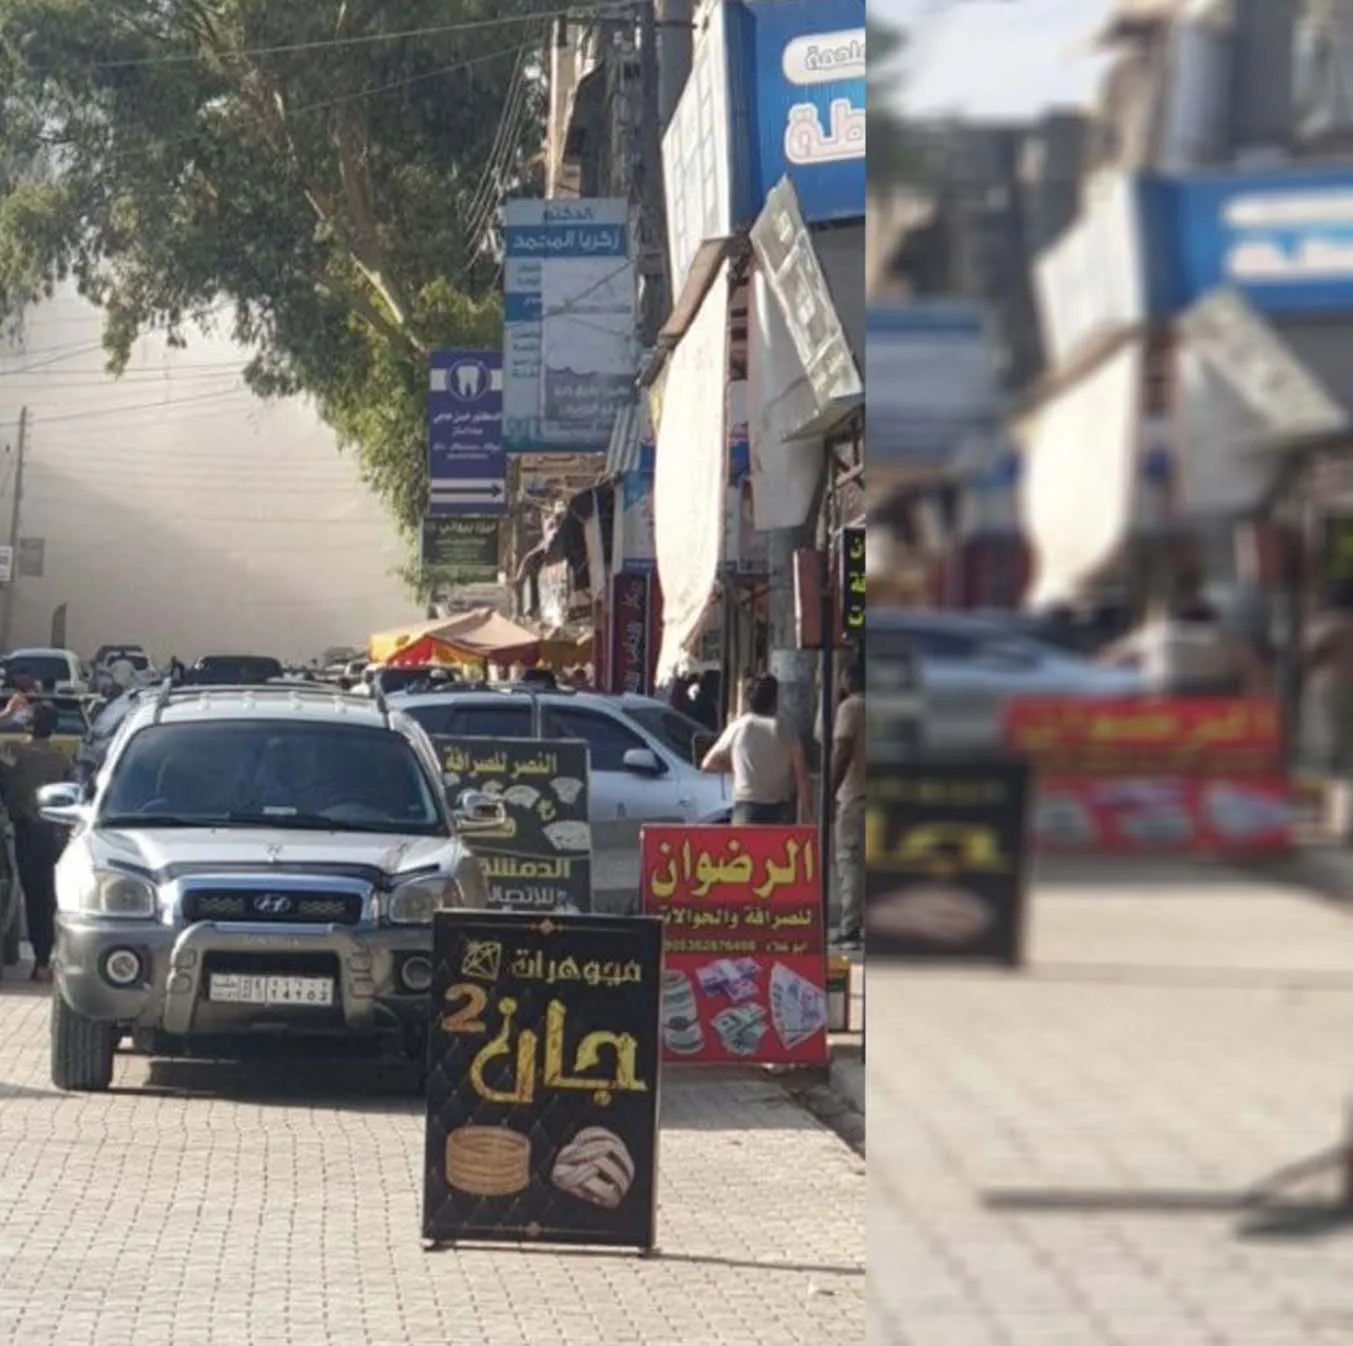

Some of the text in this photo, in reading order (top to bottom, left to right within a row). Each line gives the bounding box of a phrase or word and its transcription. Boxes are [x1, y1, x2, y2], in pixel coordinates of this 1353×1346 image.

[651, 838, 814, 898] الرضوان
[744, 903, 813, 930] للصرافة
[512, 949, 642, 987] مجوهرات
[441, 982, 488, 1033] 2
